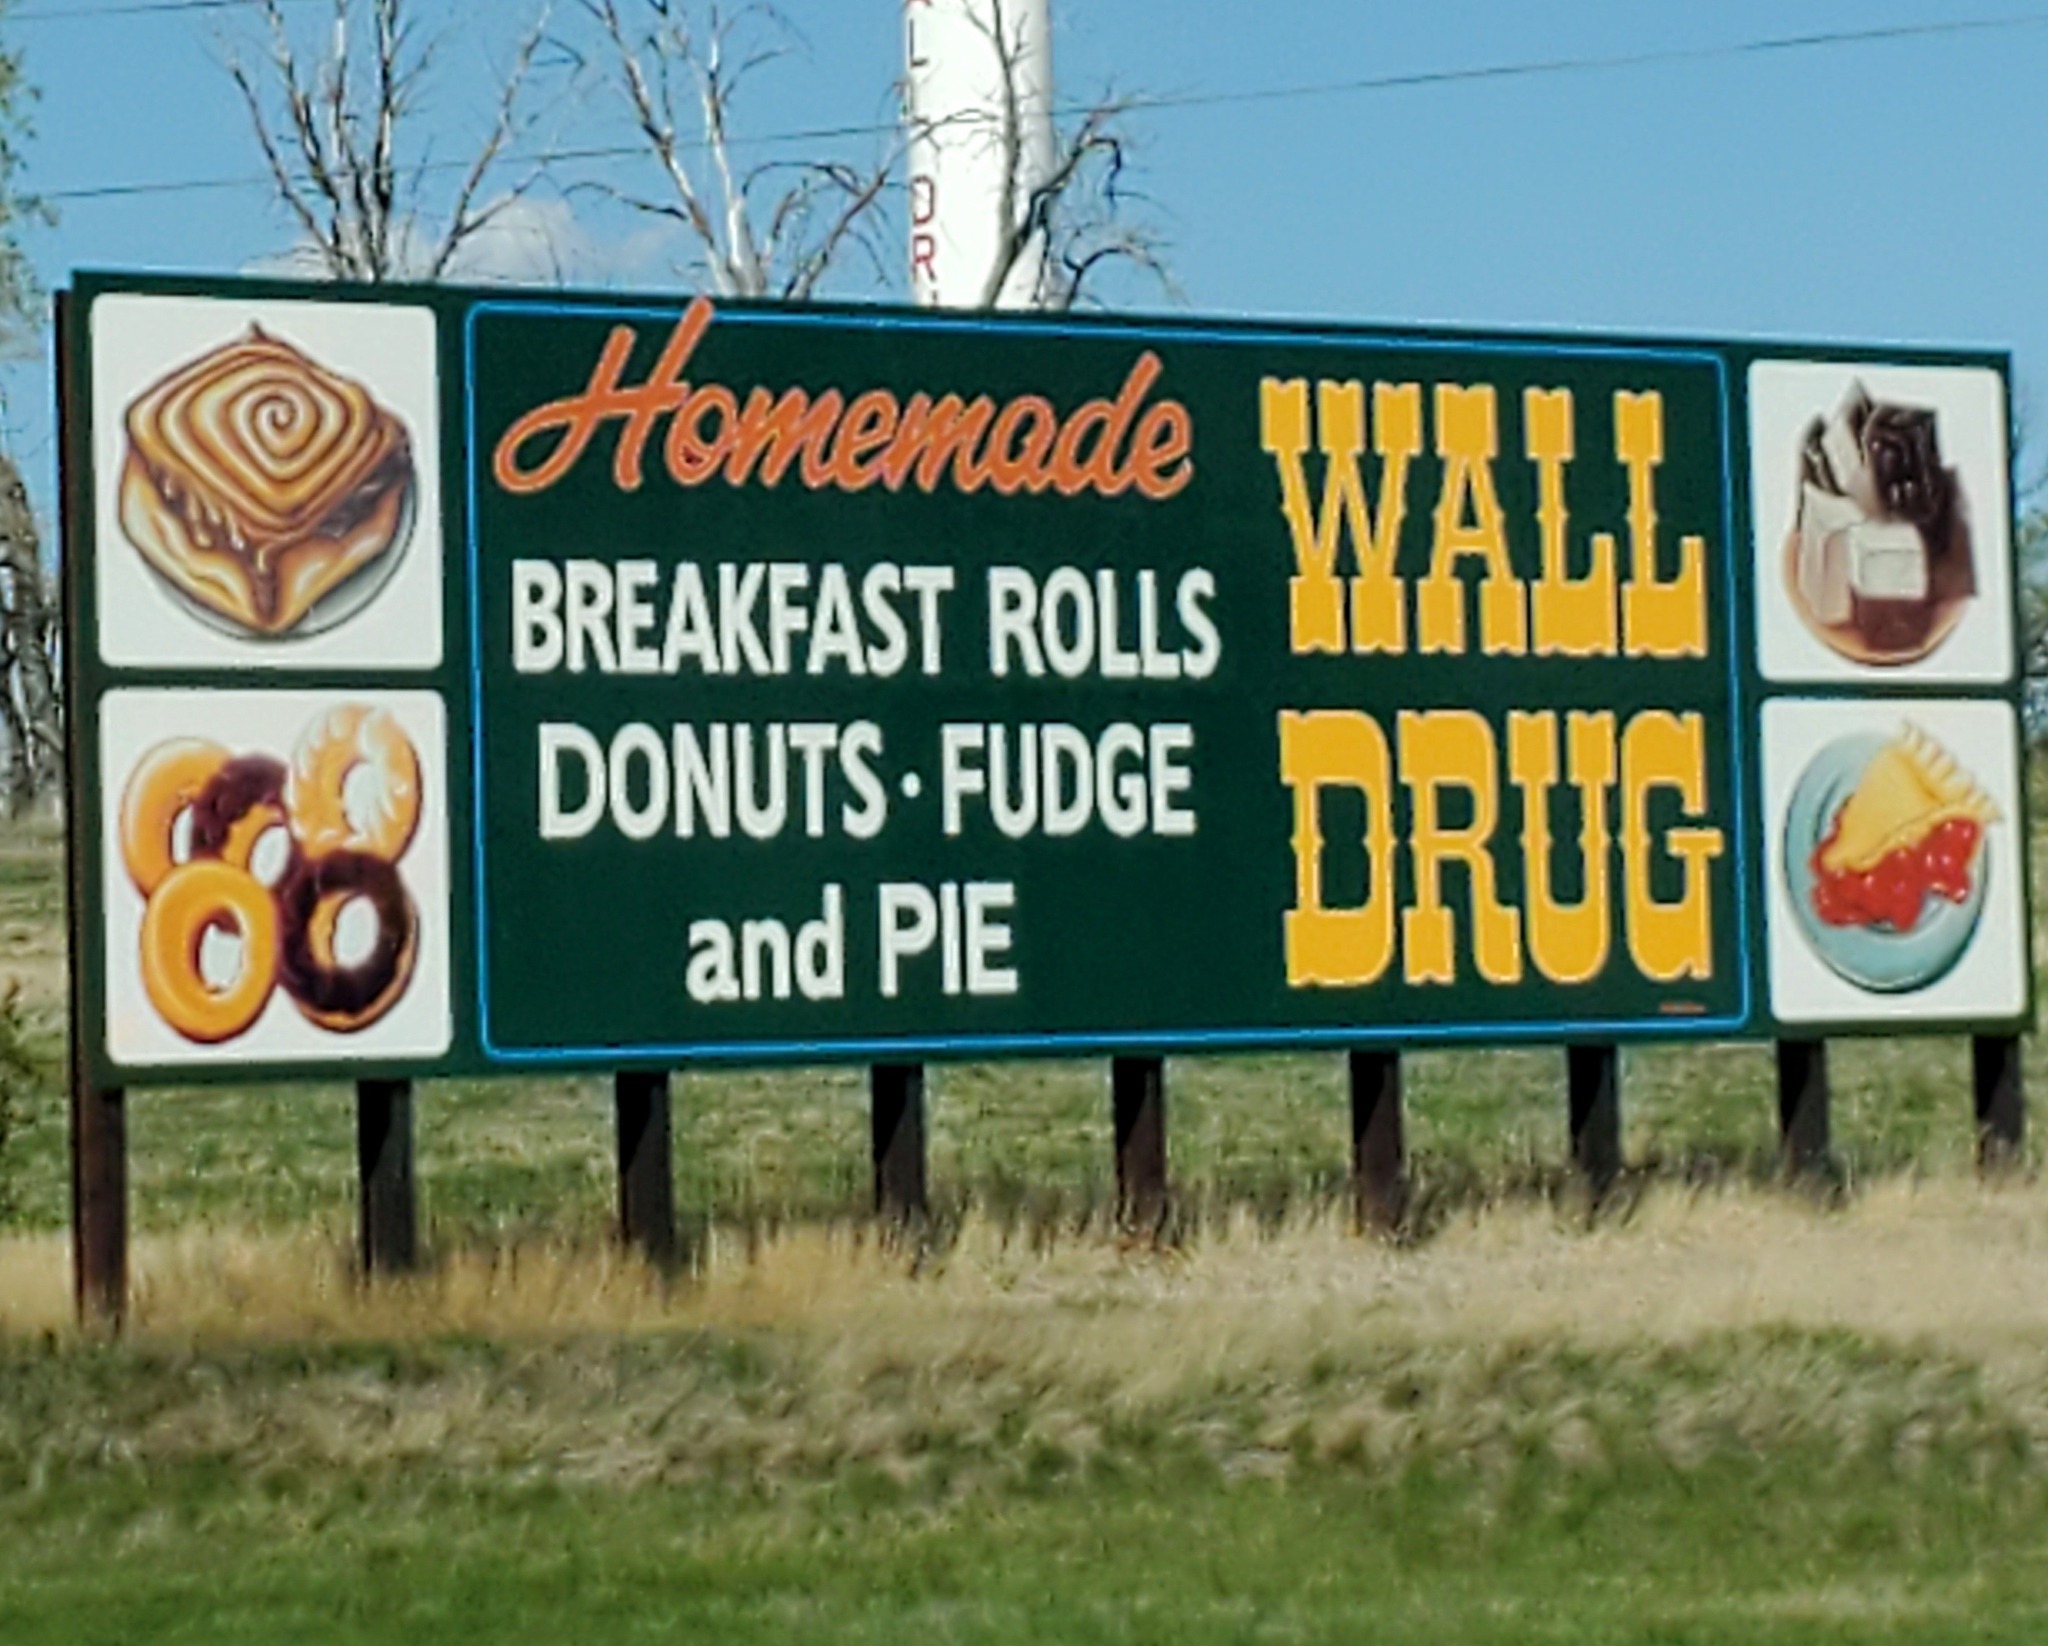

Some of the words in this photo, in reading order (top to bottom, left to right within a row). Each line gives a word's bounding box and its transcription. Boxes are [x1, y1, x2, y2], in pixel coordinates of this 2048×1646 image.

[493, 299, 1193, 498] Homemade
[1258, 376, 1708, 657] WALL
[512, 559, 955, 676] BREAKFAST
[988, 567, 1221, 679] ROLLS
[538, 721, 887, 839] DONUTS
[941, 722, 1196, 837] FUDGE
[1279, 706, 1725, 988] DRUG
[686, 883, 844, 1003] and
[879, 882, 1018, 997] PIE
